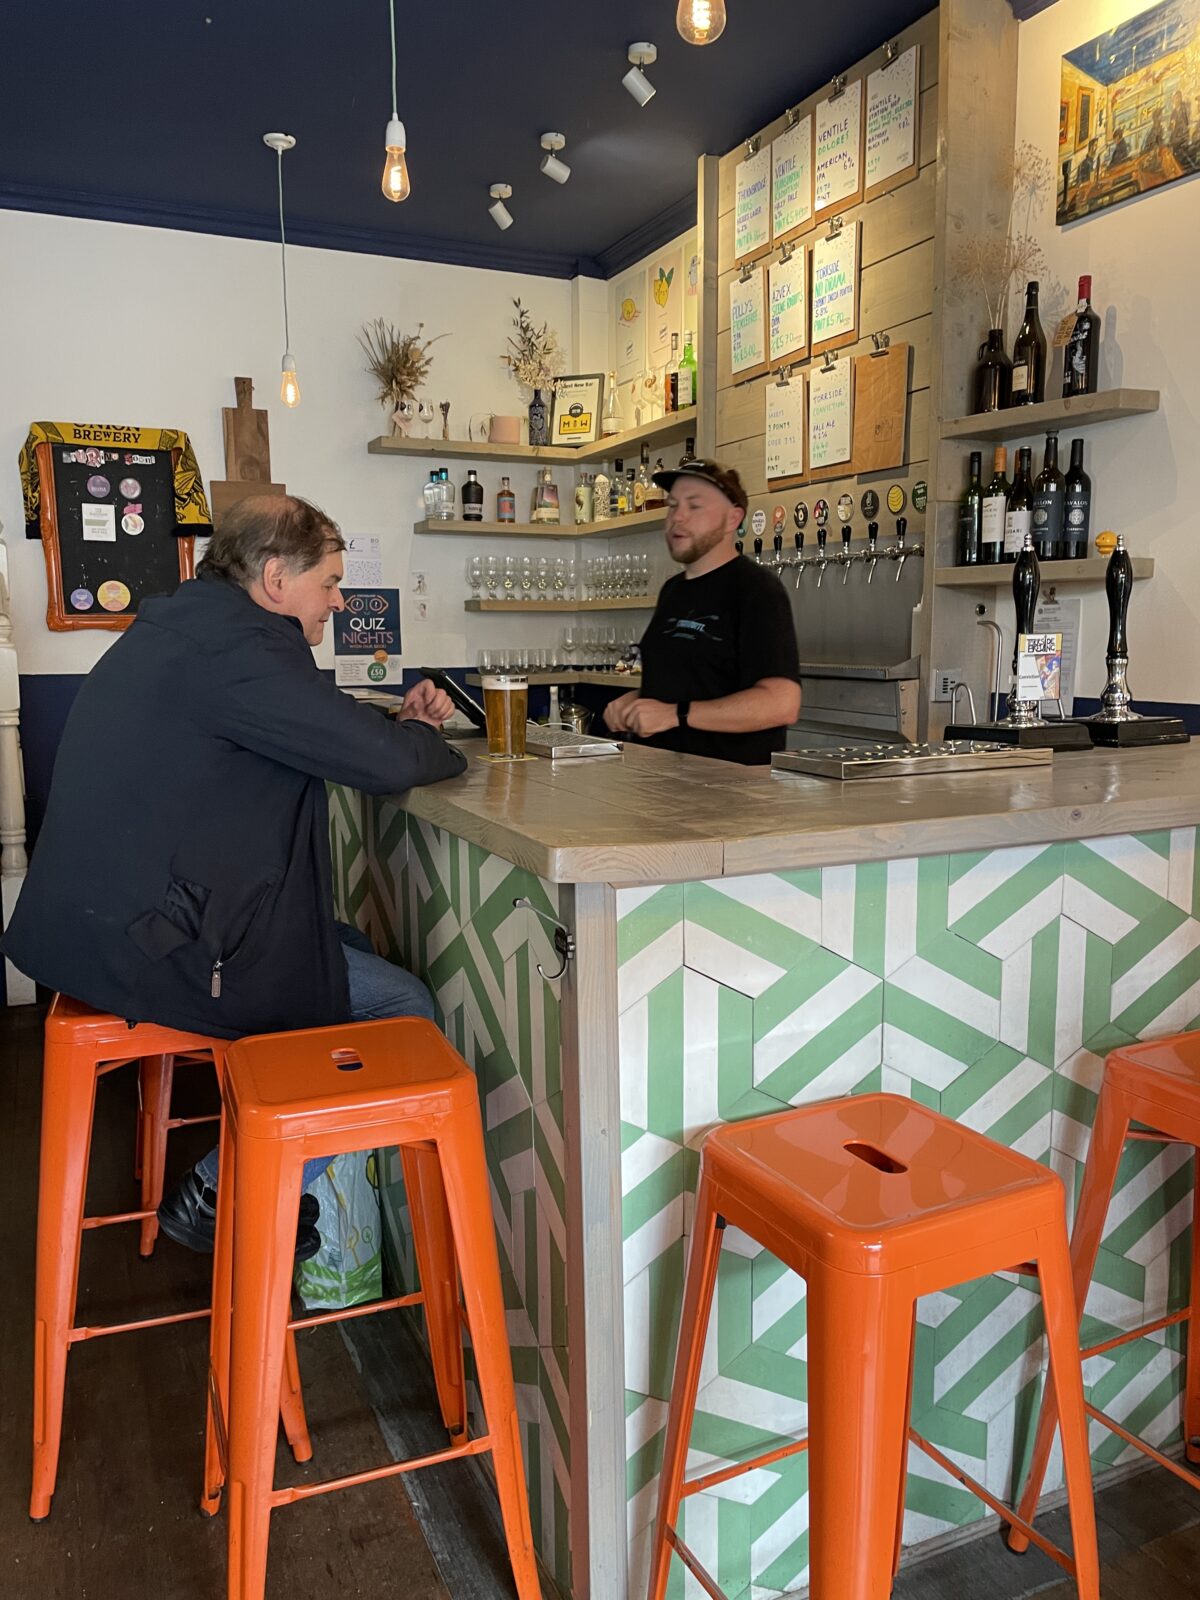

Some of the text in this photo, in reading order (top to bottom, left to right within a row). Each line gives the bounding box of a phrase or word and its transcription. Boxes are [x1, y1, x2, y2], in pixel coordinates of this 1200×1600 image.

[818, 118, 849, 143] VENTILE
[817, 131, 850, 156] DOLORES
[816, 151, 848, 173] AMERICAN
[816, 172, 826, 183] IPA
[73, 429, 142, 444] BREWERY
[349, 617, 386, 632] QUIZ
[342, 631, 394, 644] NIGHTS
[370, 668, 384, 676] £50
